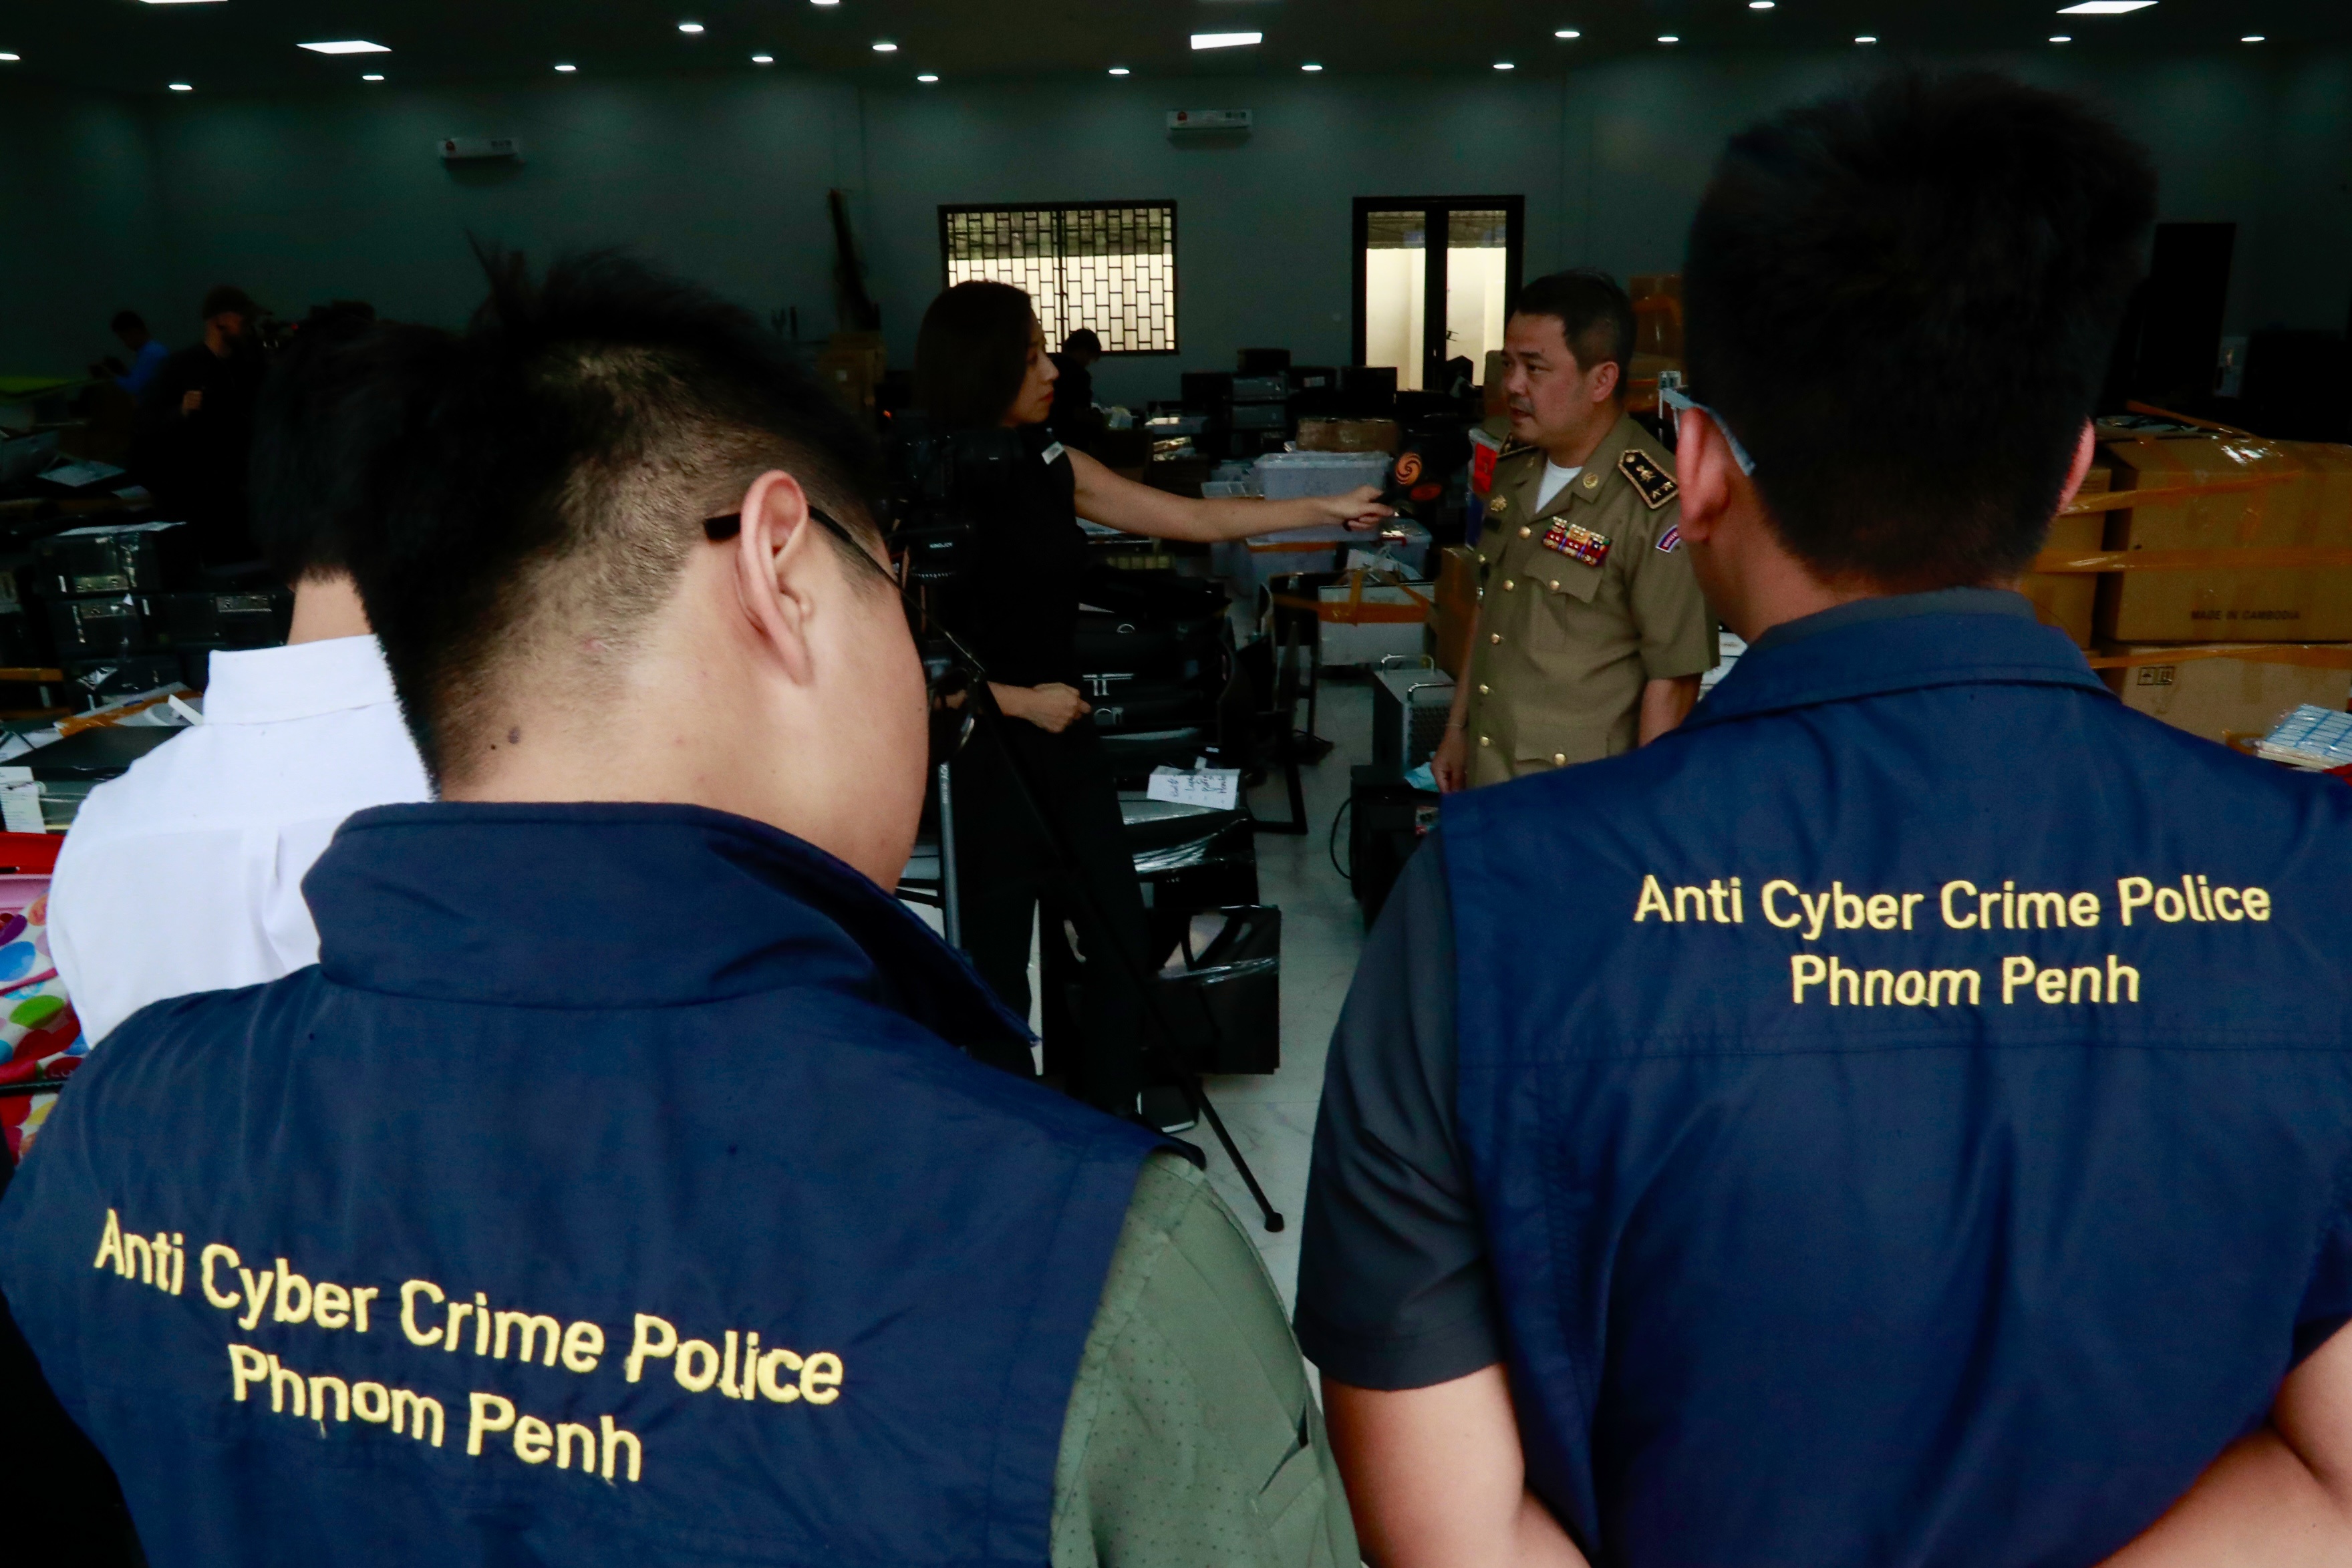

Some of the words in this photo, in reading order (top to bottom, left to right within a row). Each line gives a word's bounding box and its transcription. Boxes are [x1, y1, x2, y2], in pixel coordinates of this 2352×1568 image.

[2192, 610, 2221, 620] MADE
[2242, 610, 2300, 620] CAMBODIA
[1634, 874, 1743, 923] Anti
[1761, 879, 1924, 941] Cyber
[1940, 880, 2100, 930] Crime
[2117, 875, 2270, 927] Police
[1791, 954, 1980, 1007] Phnom
[2003, 954, 2140, 1005] Penh
[94, 1209, 184, 1295] Anti
[200, 1243, 379, 1333] Cyber
[400, 1279, 605, 1373] Crime
[625, 1312, 843, 1405] Police
[228, 1344, 444, 1448] Phnom
[466, 1392, 641, 1482] Penh
